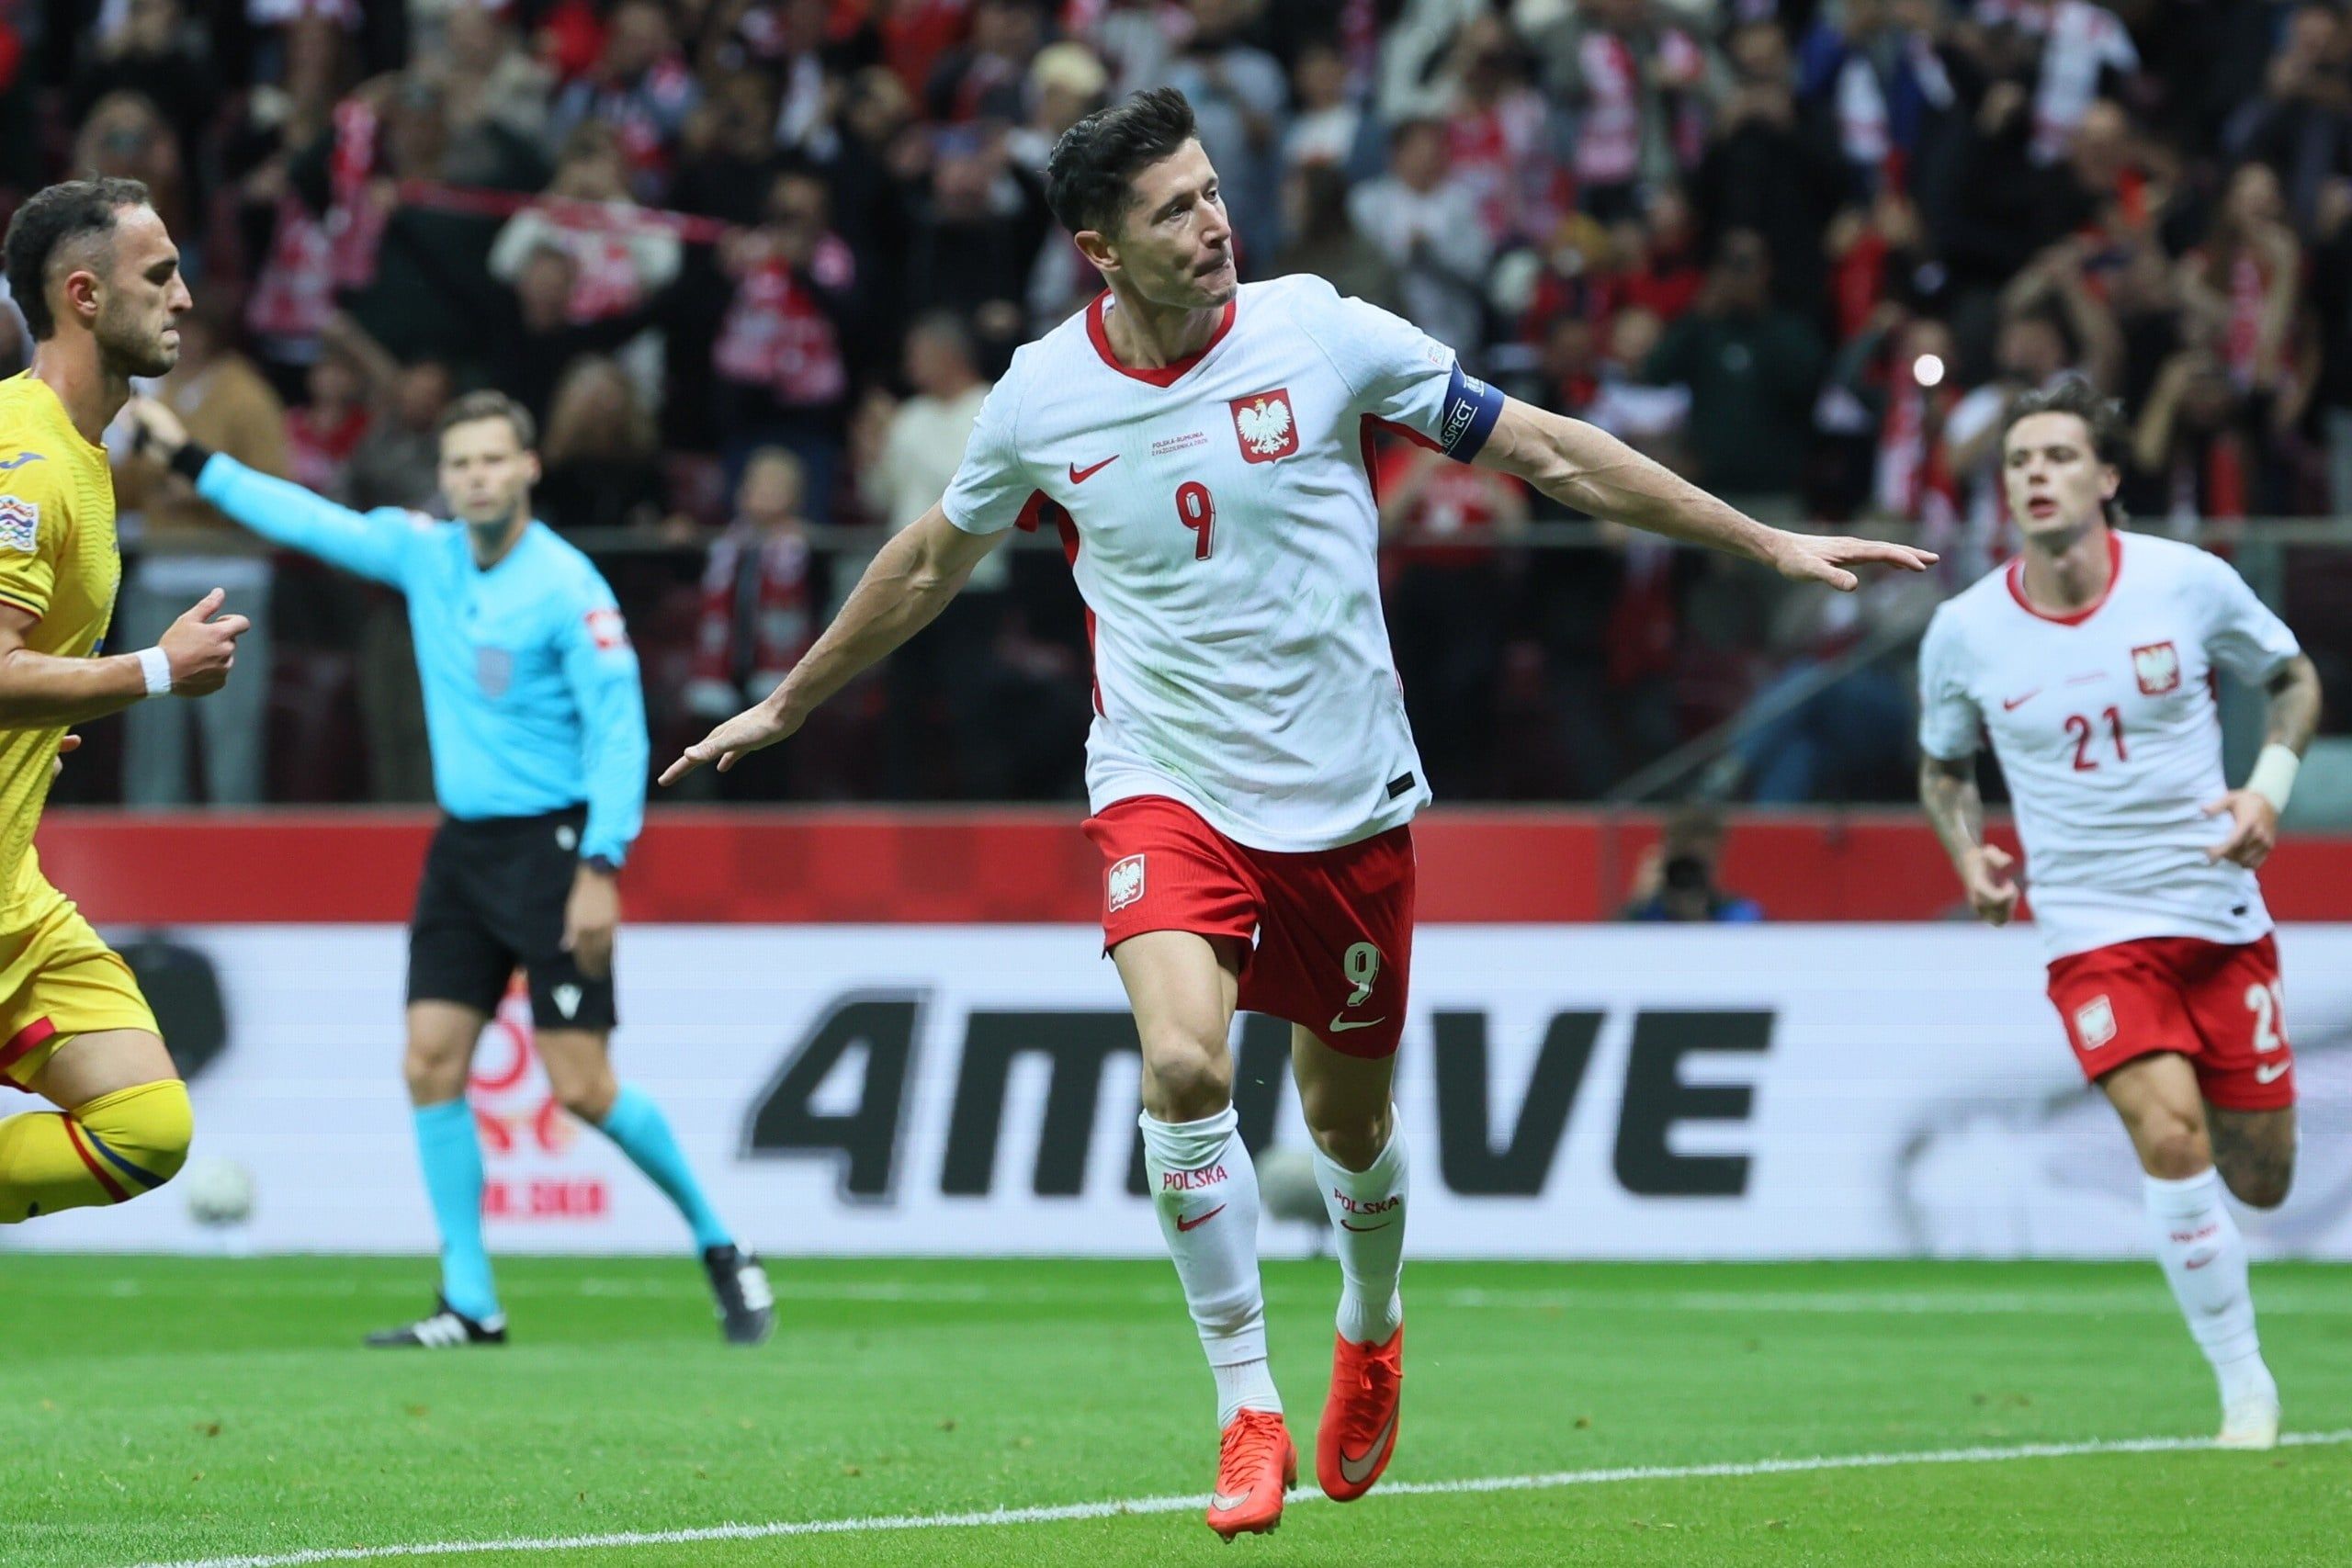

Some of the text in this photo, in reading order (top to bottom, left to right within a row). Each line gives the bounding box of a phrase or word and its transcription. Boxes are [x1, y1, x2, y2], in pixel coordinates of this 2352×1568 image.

[1175, 480, 1216, 561] 9
[2064, 704, 2130, 773] 21
[1343, 942, 1381, 1008] 9
[1162, 1165, 1228, 1191] POLSKA
[1333, 1187, 1400, 1215] POLSKA
